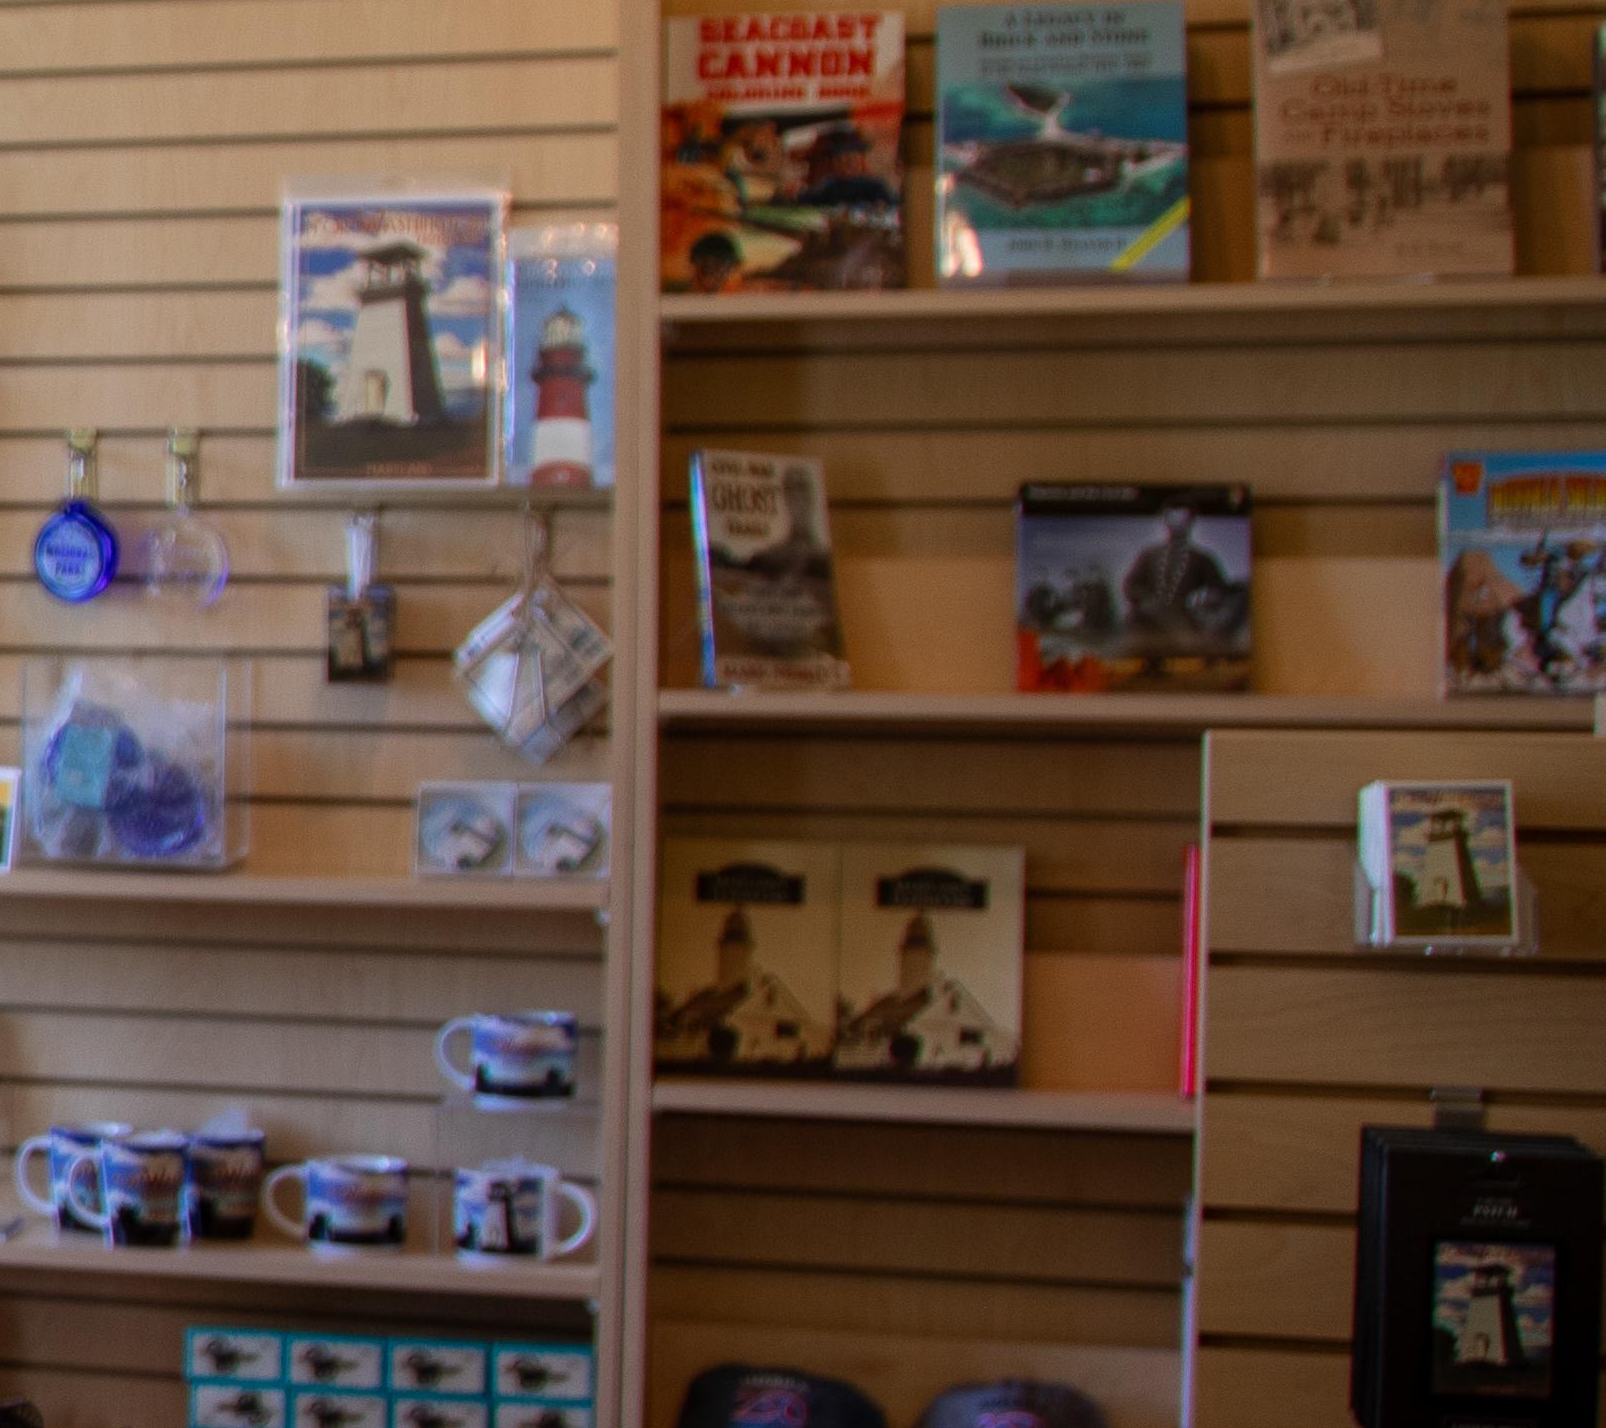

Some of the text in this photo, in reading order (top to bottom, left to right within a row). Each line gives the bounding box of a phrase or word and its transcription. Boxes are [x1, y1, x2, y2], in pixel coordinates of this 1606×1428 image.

[698, 14, 883, 45] SEACOAST
[697, 46, 877, 80] CANNON
[1320, 124, 1491, 150] Fireplaces
[712, 486, 781, 515] GHOST
